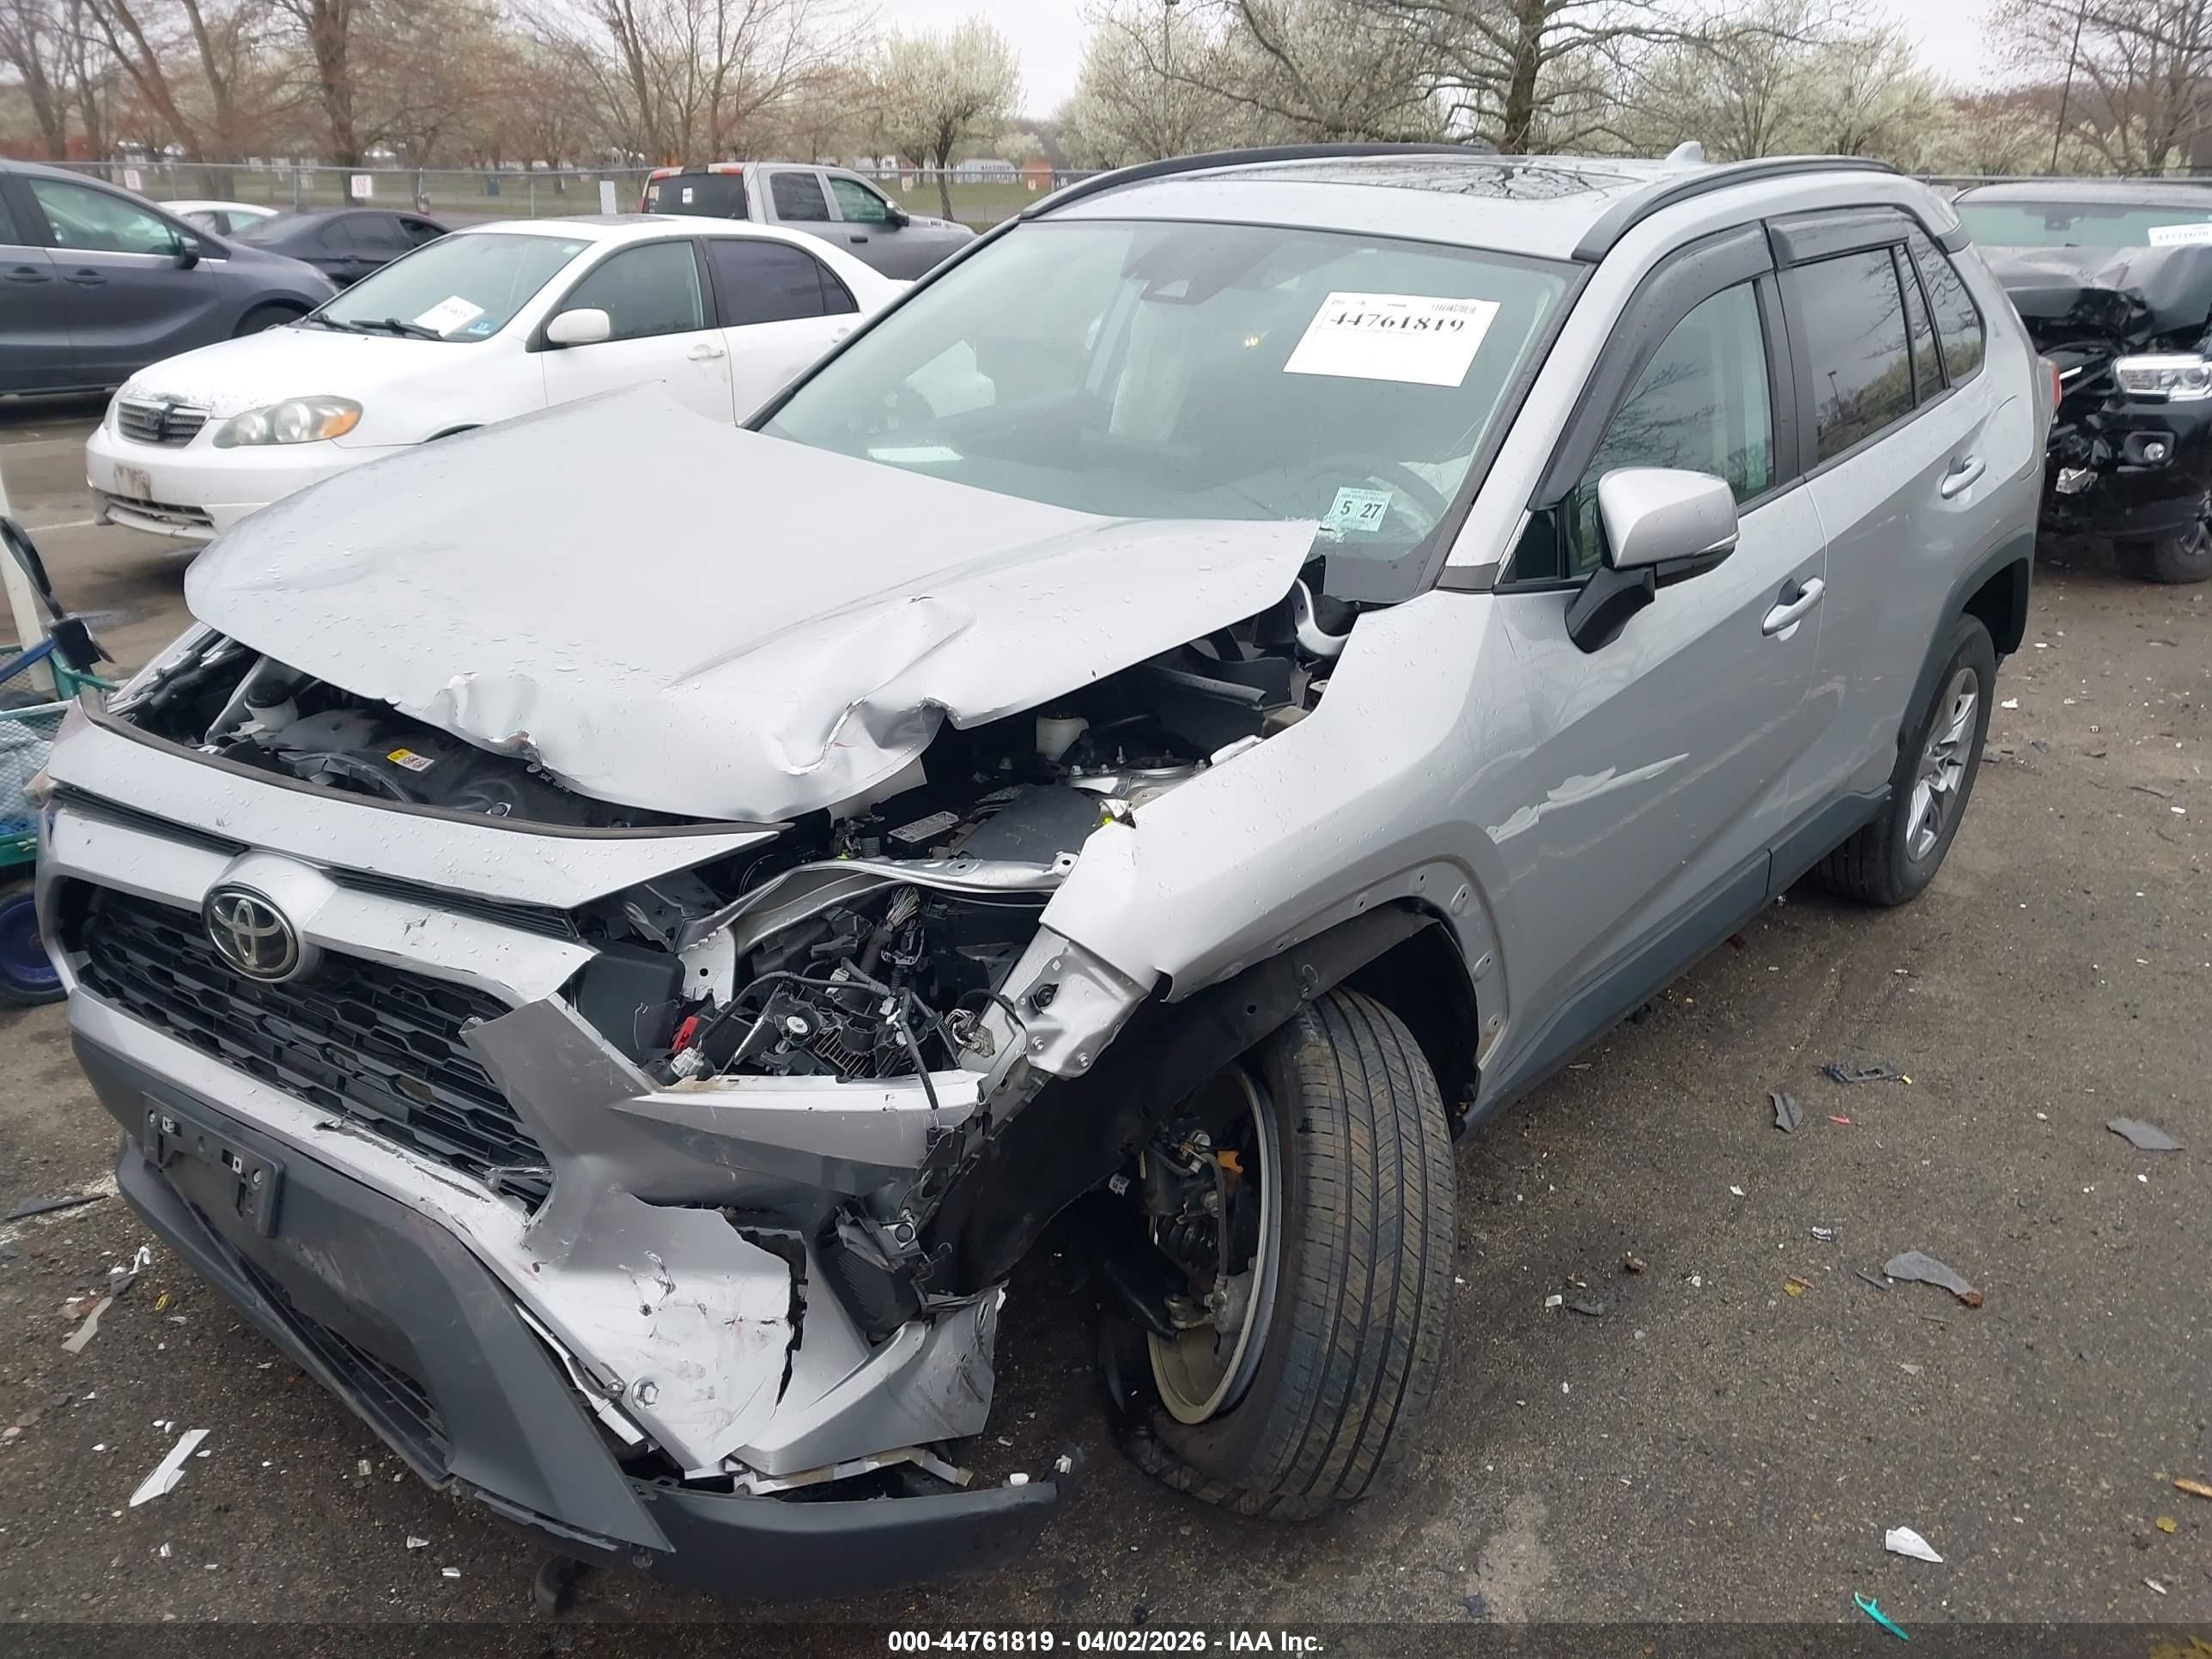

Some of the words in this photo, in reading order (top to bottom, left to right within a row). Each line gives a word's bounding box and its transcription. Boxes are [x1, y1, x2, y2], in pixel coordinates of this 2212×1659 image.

[1330, 311, 1465, 332] 44761819
[1340, 501, 1353, 515] 5
[1360, 503, 1382, 519] 27
